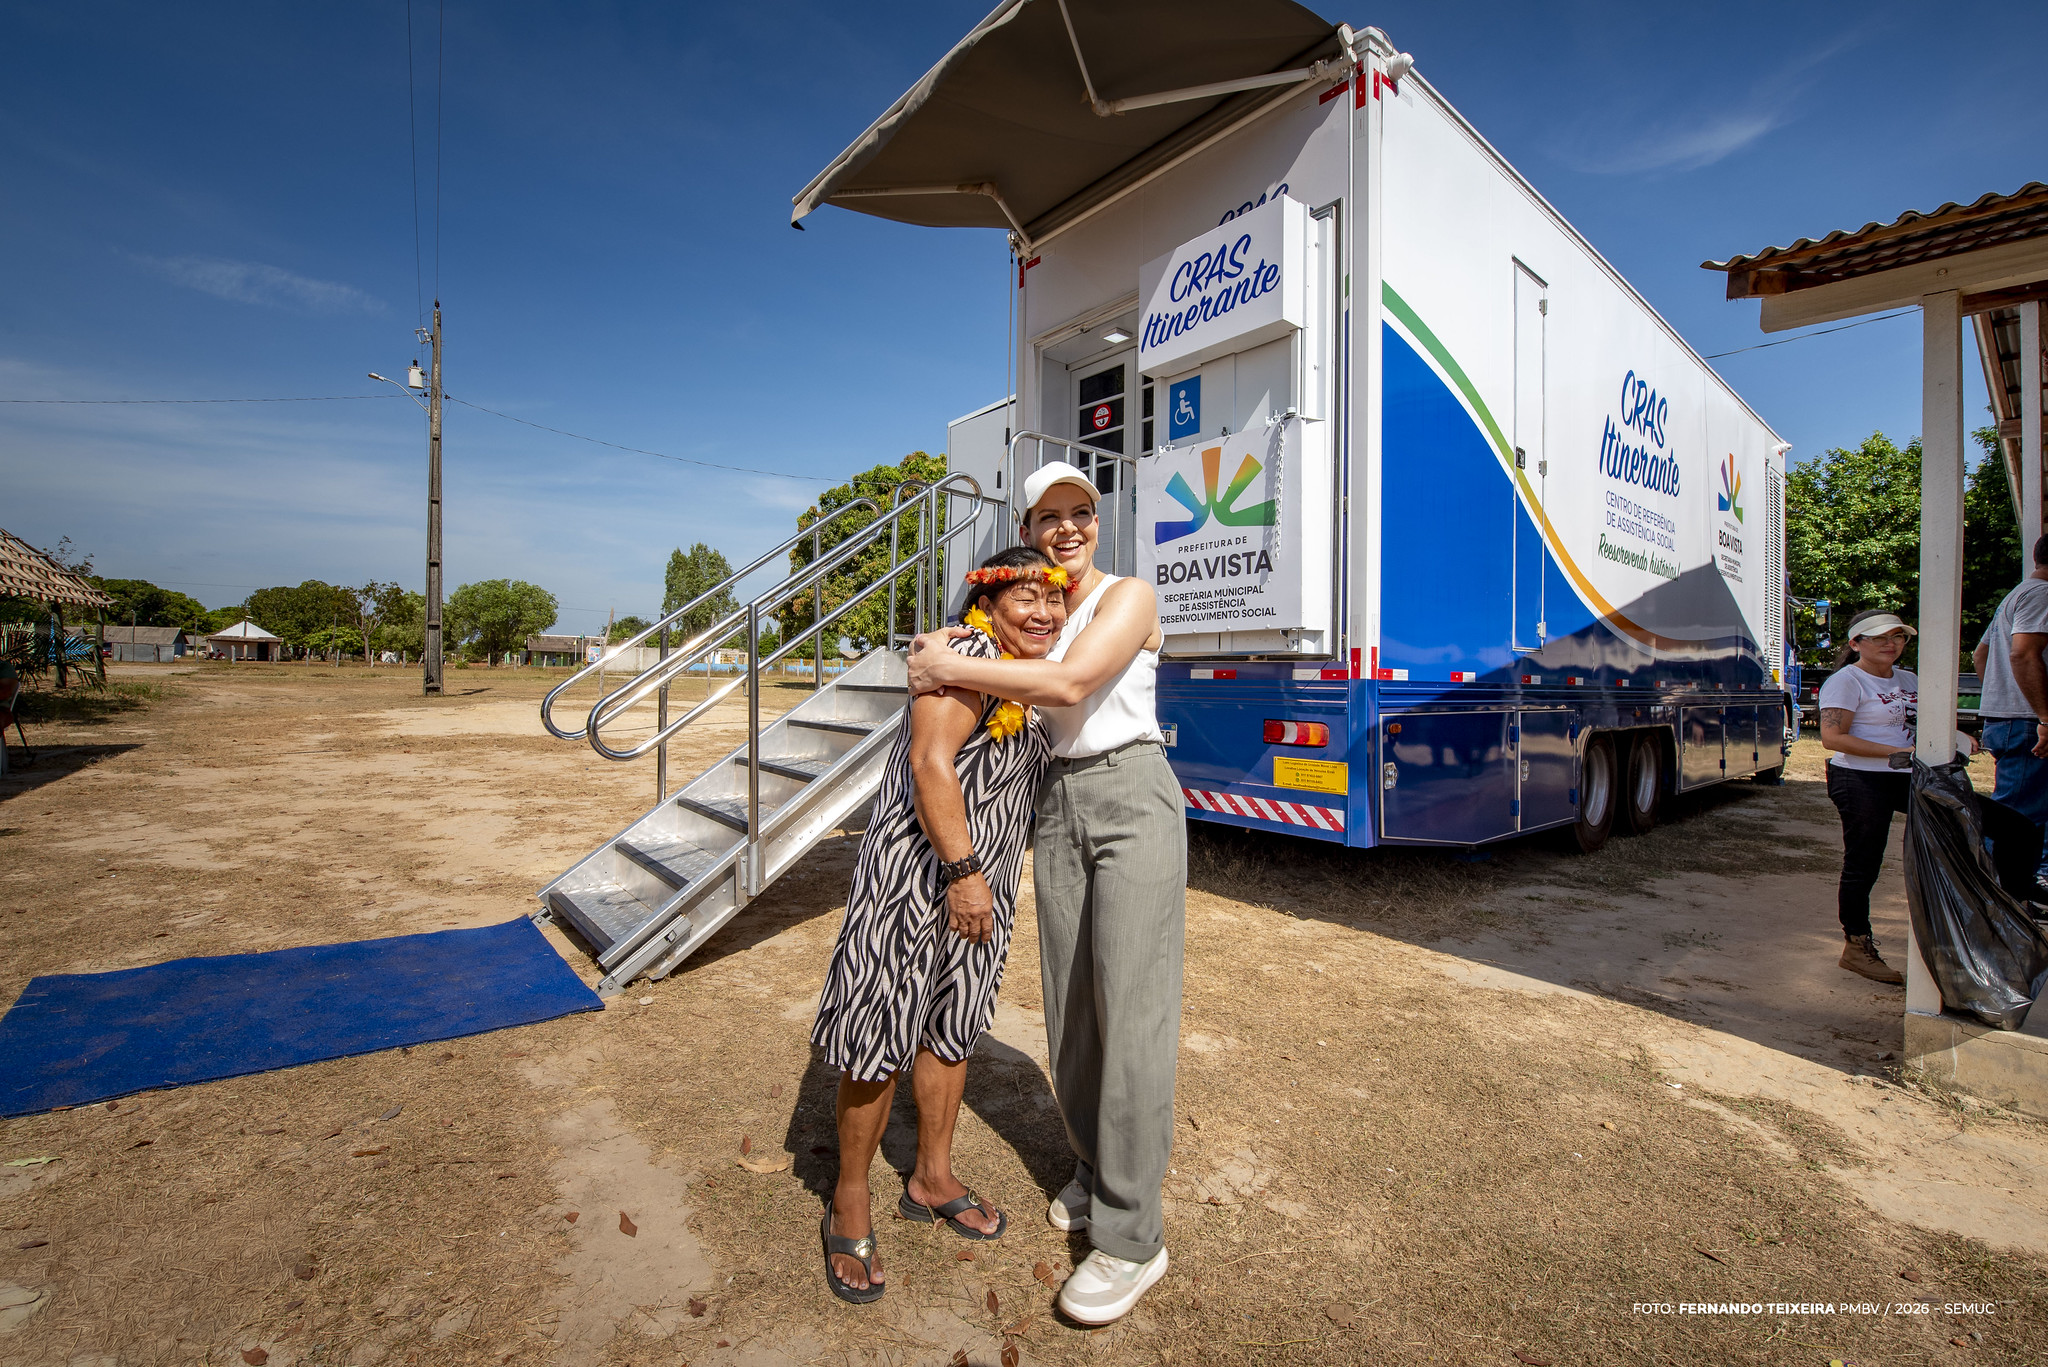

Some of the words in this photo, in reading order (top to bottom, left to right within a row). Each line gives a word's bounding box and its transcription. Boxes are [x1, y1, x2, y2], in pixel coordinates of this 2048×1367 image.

[1170, 233, 1251, 303] CRAS
[1141, 258, 1281, 353] Itinerante
[1621, 369, 1668, 449] CRAS
[1599, 413, 1681, 498] Itinerante
[1606, 490, 1633, 515] CENTRO
[1634, 503, 1642, 520] DE
[1178, 538, 1233, 554] PREFEITURA
[1235, 536, 1248, 546] DE
[1606, 510, 1616, 528] DE
[1656, 532, 1676, 552] SOCIAL
[1598, 532, 1648, 572] Reescrevendo
[1164, 590, 1213, 603] SECRETARIA
[1214, 585, 1264, 599] MUNICIPAL
[1179, 603, 1190, 612] DE
[1191, 597, 1246, 611] ASSISTÊNCIA
[1160, 609, 1240, 624] DESENVOLVIMENTO
[1241, 607, 1277, 618] SOCIAL
